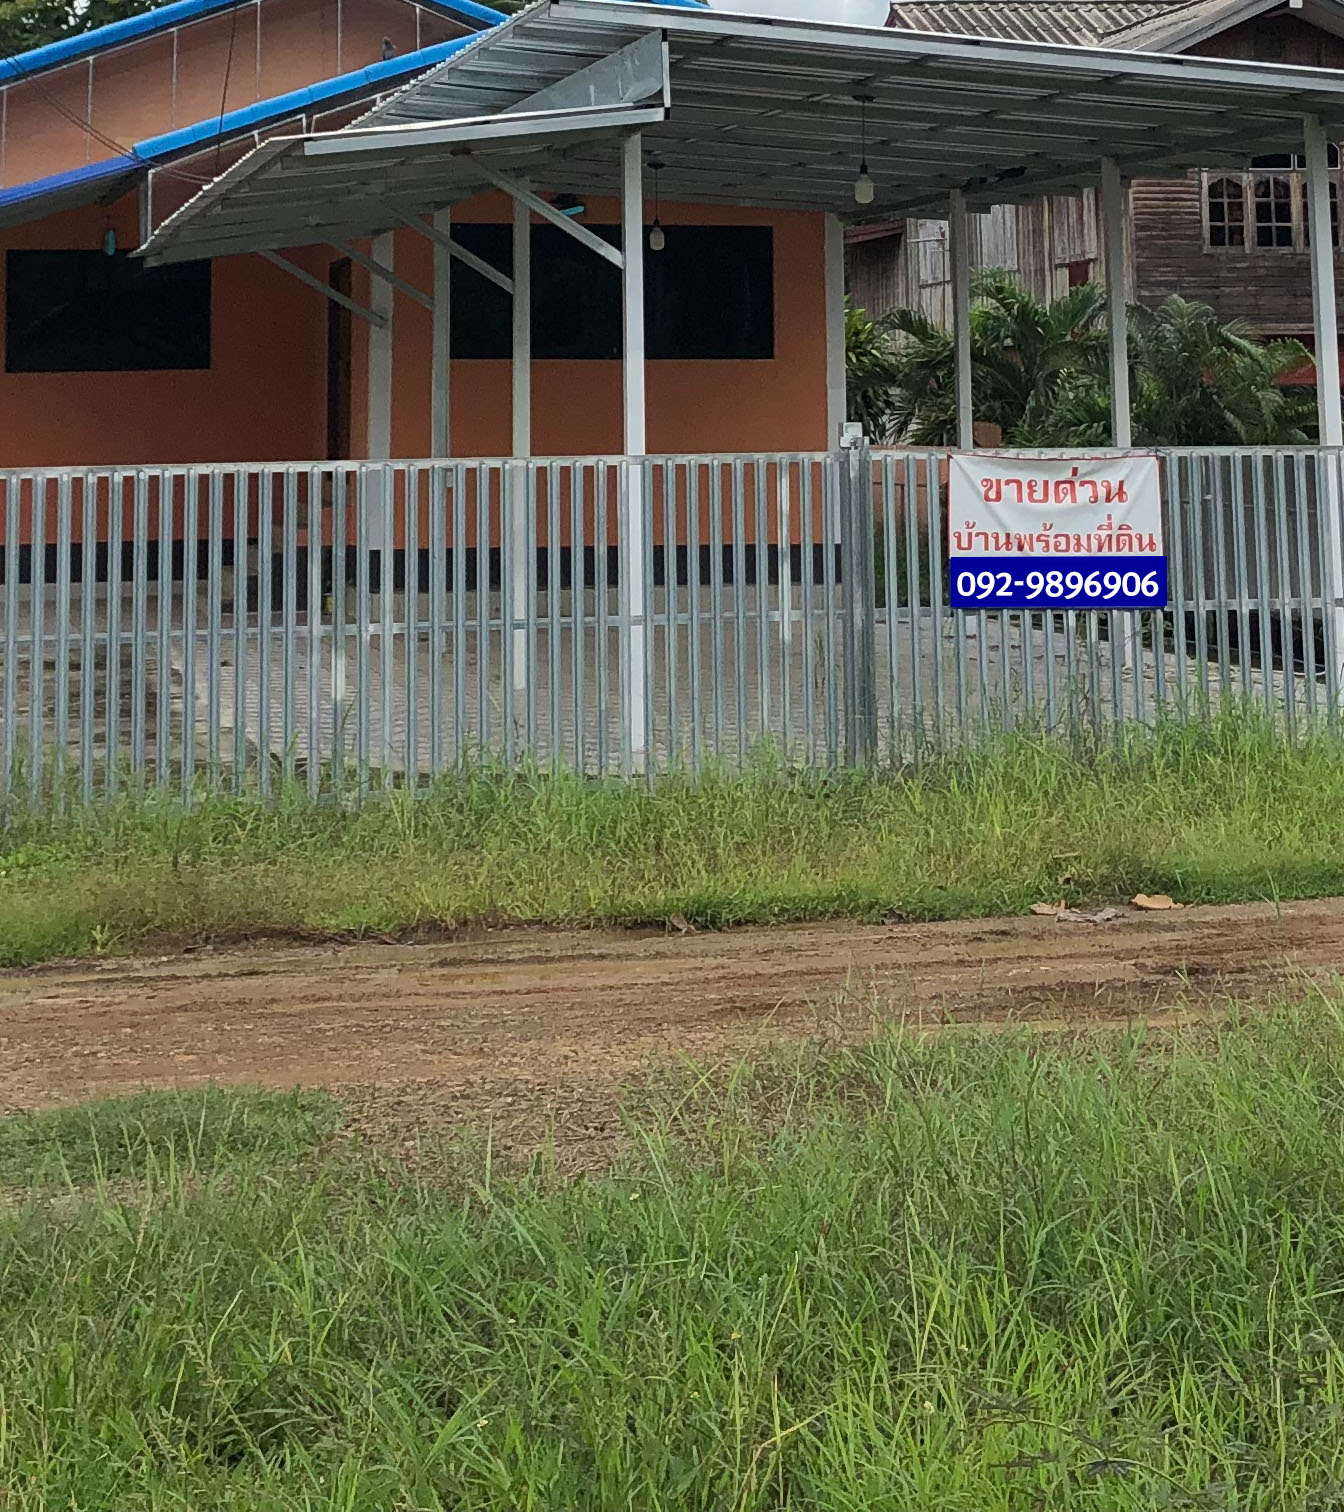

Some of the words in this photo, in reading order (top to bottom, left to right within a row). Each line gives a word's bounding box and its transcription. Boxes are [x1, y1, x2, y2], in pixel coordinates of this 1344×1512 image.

[981, 467, 1129, 504] ขายด่วน
[953, 514, 1157, 553] บ้านพร้อมที่ดิน
